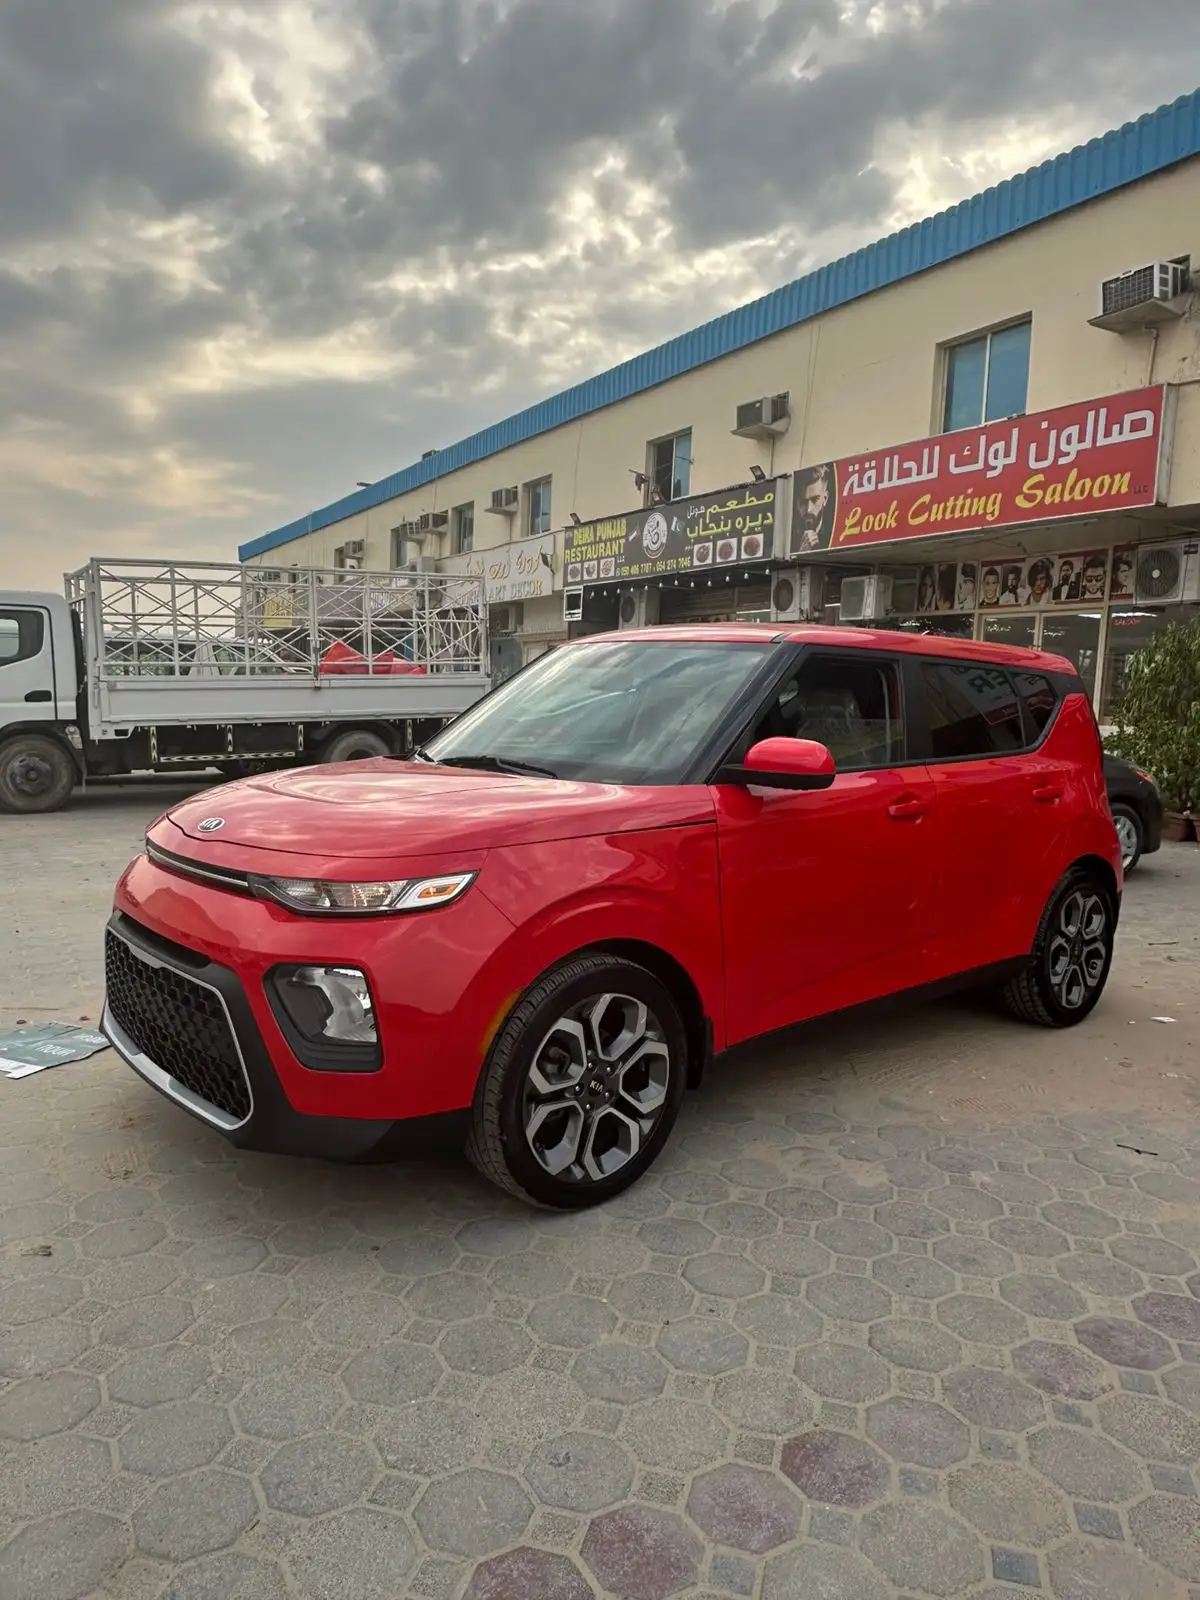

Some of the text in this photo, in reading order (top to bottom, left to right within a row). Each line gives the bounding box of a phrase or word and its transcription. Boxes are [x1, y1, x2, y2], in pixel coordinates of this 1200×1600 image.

[842, 407, 1155, 497] صالون لوك للحلاقة
[706, 491, 774, 524] مطعم
[839, 468, 1131, 542] Look Cutting Saloon
[573, 518, 627, 546] DEIRA PUNJAB
[686, 516, 732, 542] بنجاب
[564, 538, 626, 563] RESTAURANT
[589, 1080, 604, 1092] KIA
